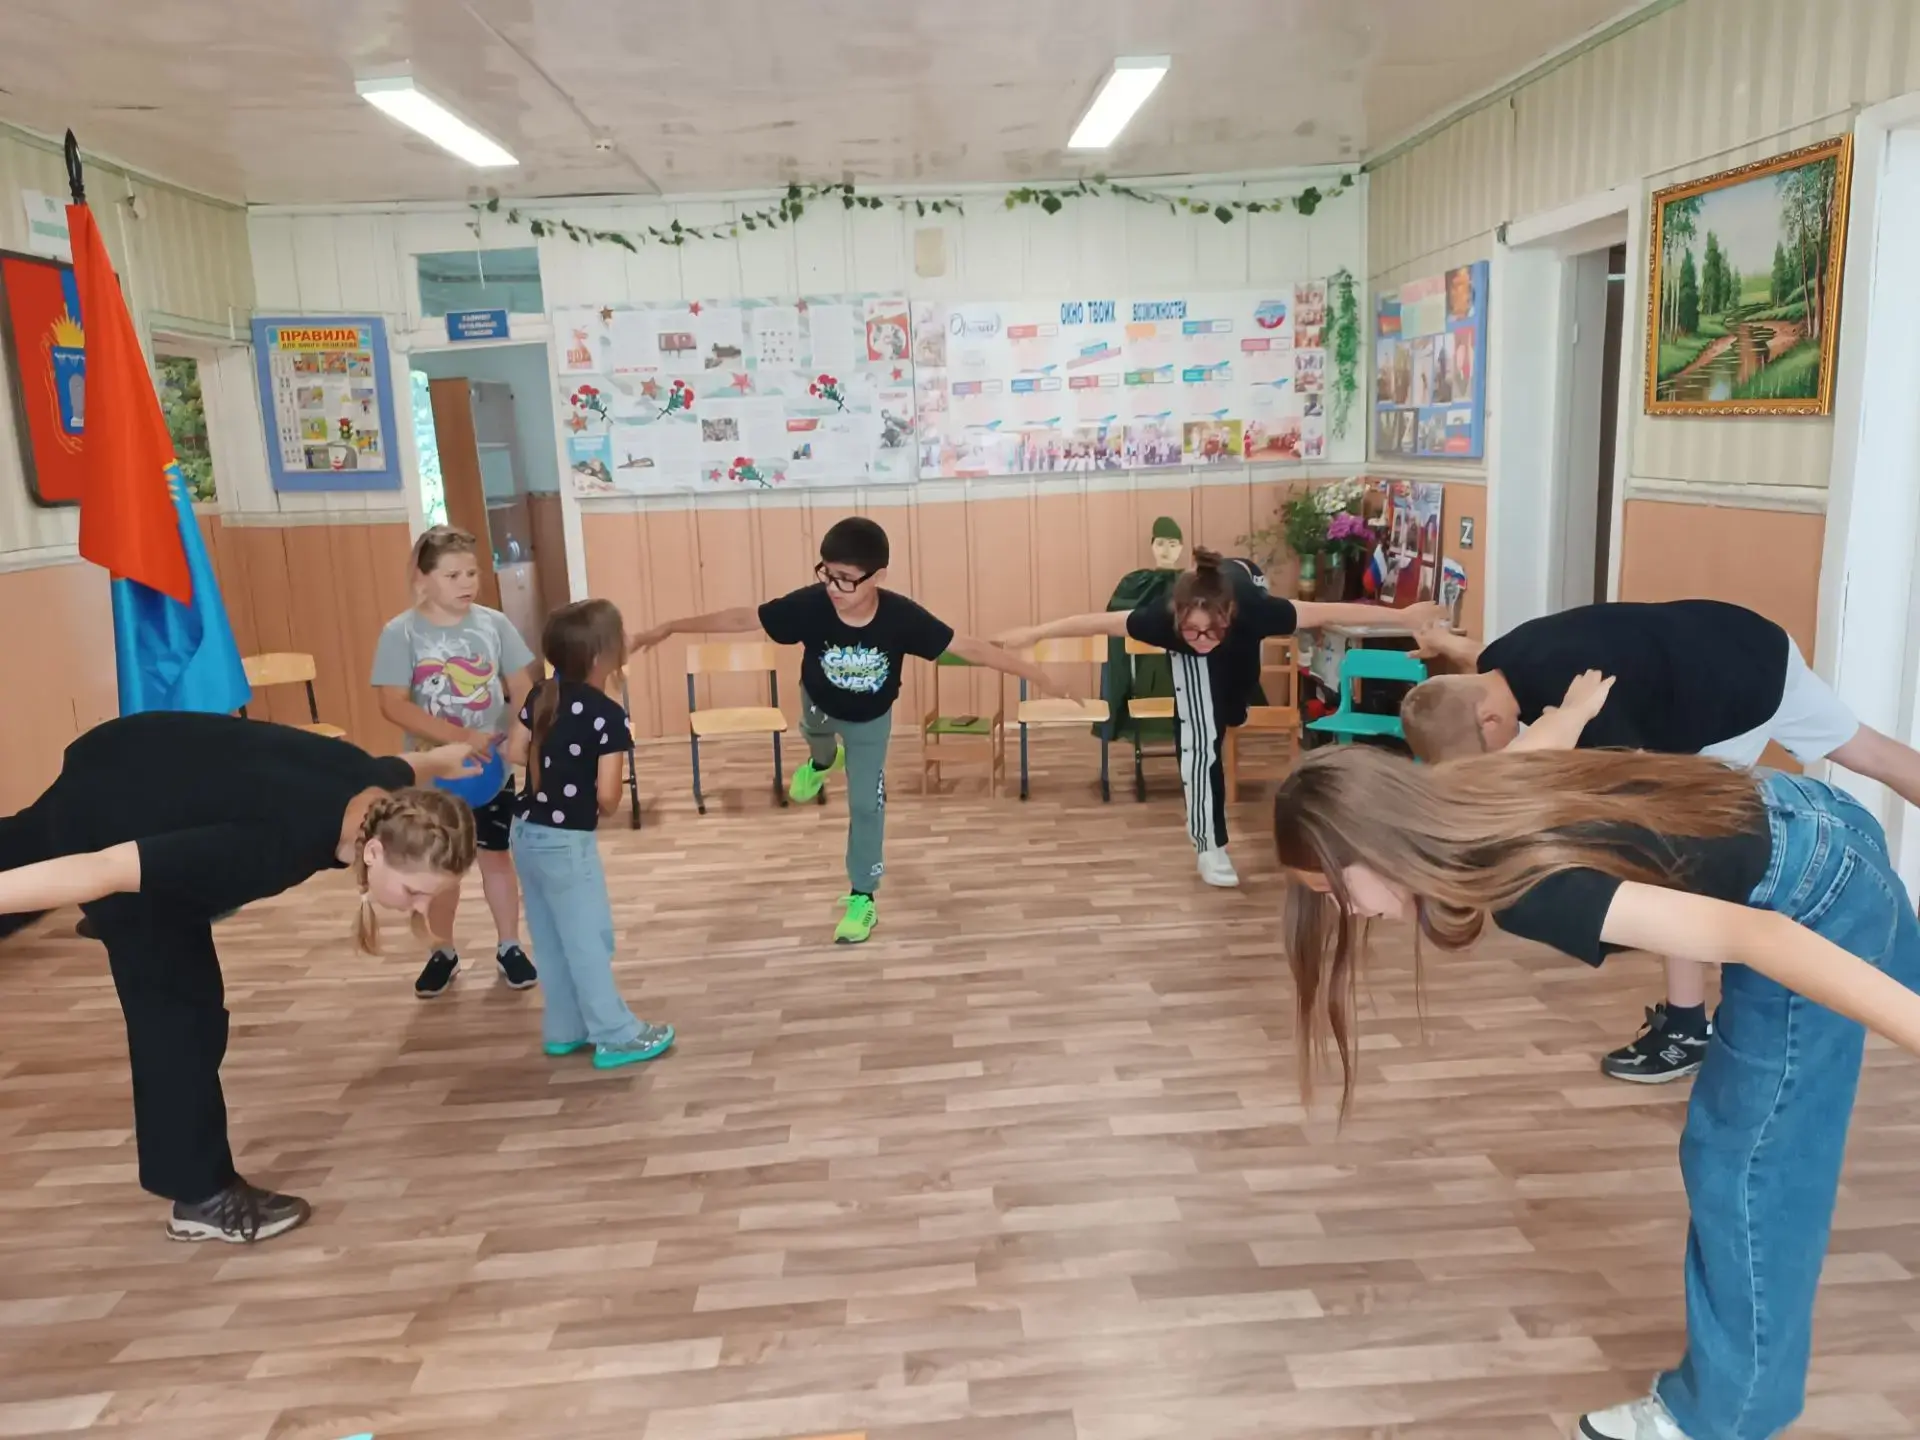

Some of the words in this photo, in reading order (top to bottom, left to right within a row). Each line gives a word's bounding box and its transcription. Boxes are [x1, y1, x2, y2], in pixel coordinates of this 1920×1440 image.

[1060, 301, 1083, 325] ОКНО
[1088, 300, 1116, 323] ТВОИХ
[280, 329, 357, 342] ПРАВИЛА
[1461, 521, 1472, 544] Z
[824, 652, 881, 667] GAME
[827, 674, 880, 692] OVER
